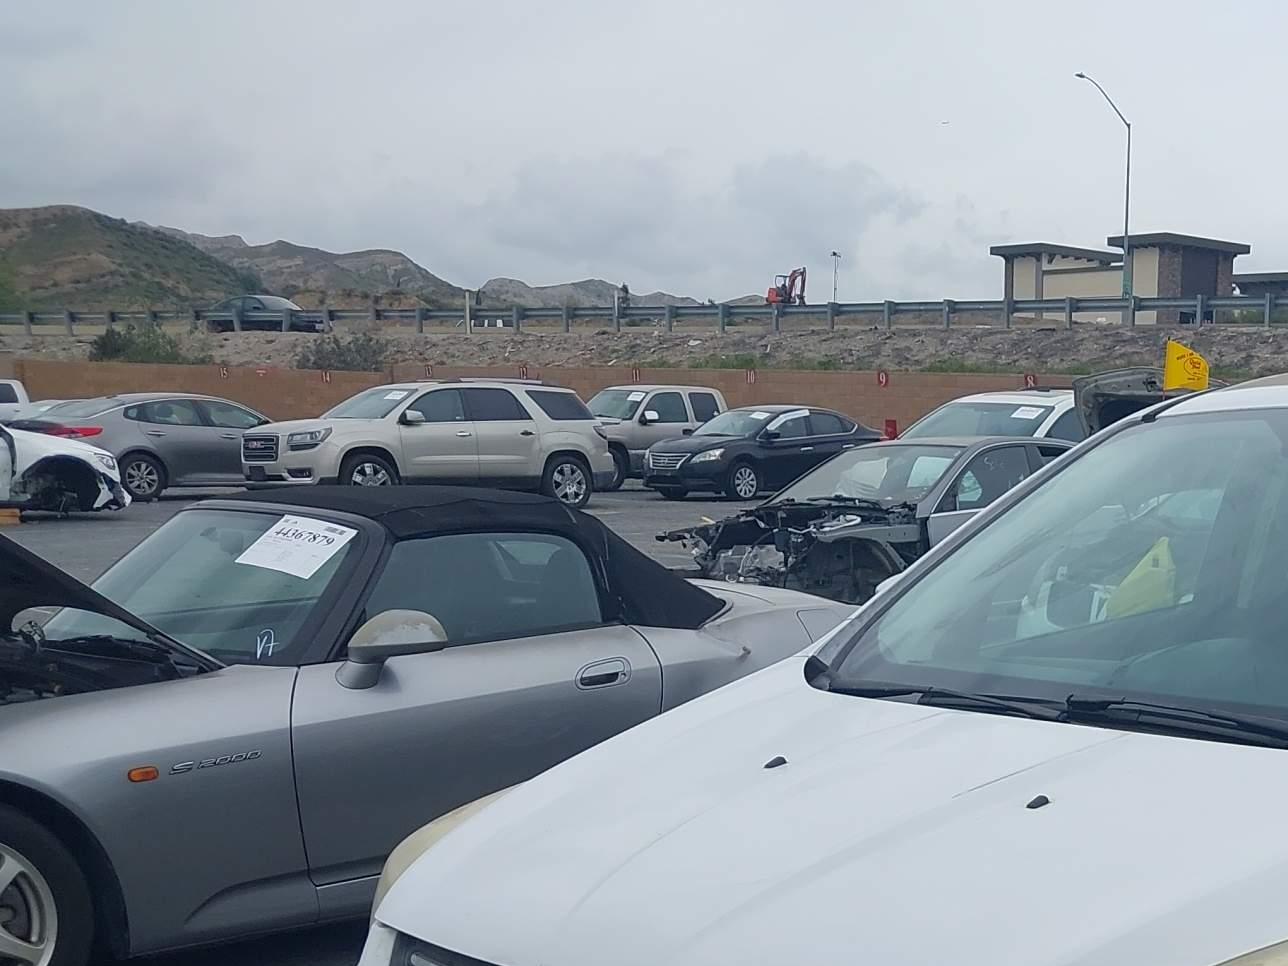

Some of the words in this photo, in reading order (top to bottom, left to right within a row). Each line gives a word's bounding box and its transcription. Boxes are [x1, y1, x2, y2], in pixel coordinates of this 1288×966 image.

[220, 367, 228, 378] 15
[747, 370, 755, 384] 10
[879, 372, 886, 386] 9
[275, 527, 335, 546] 44367879
